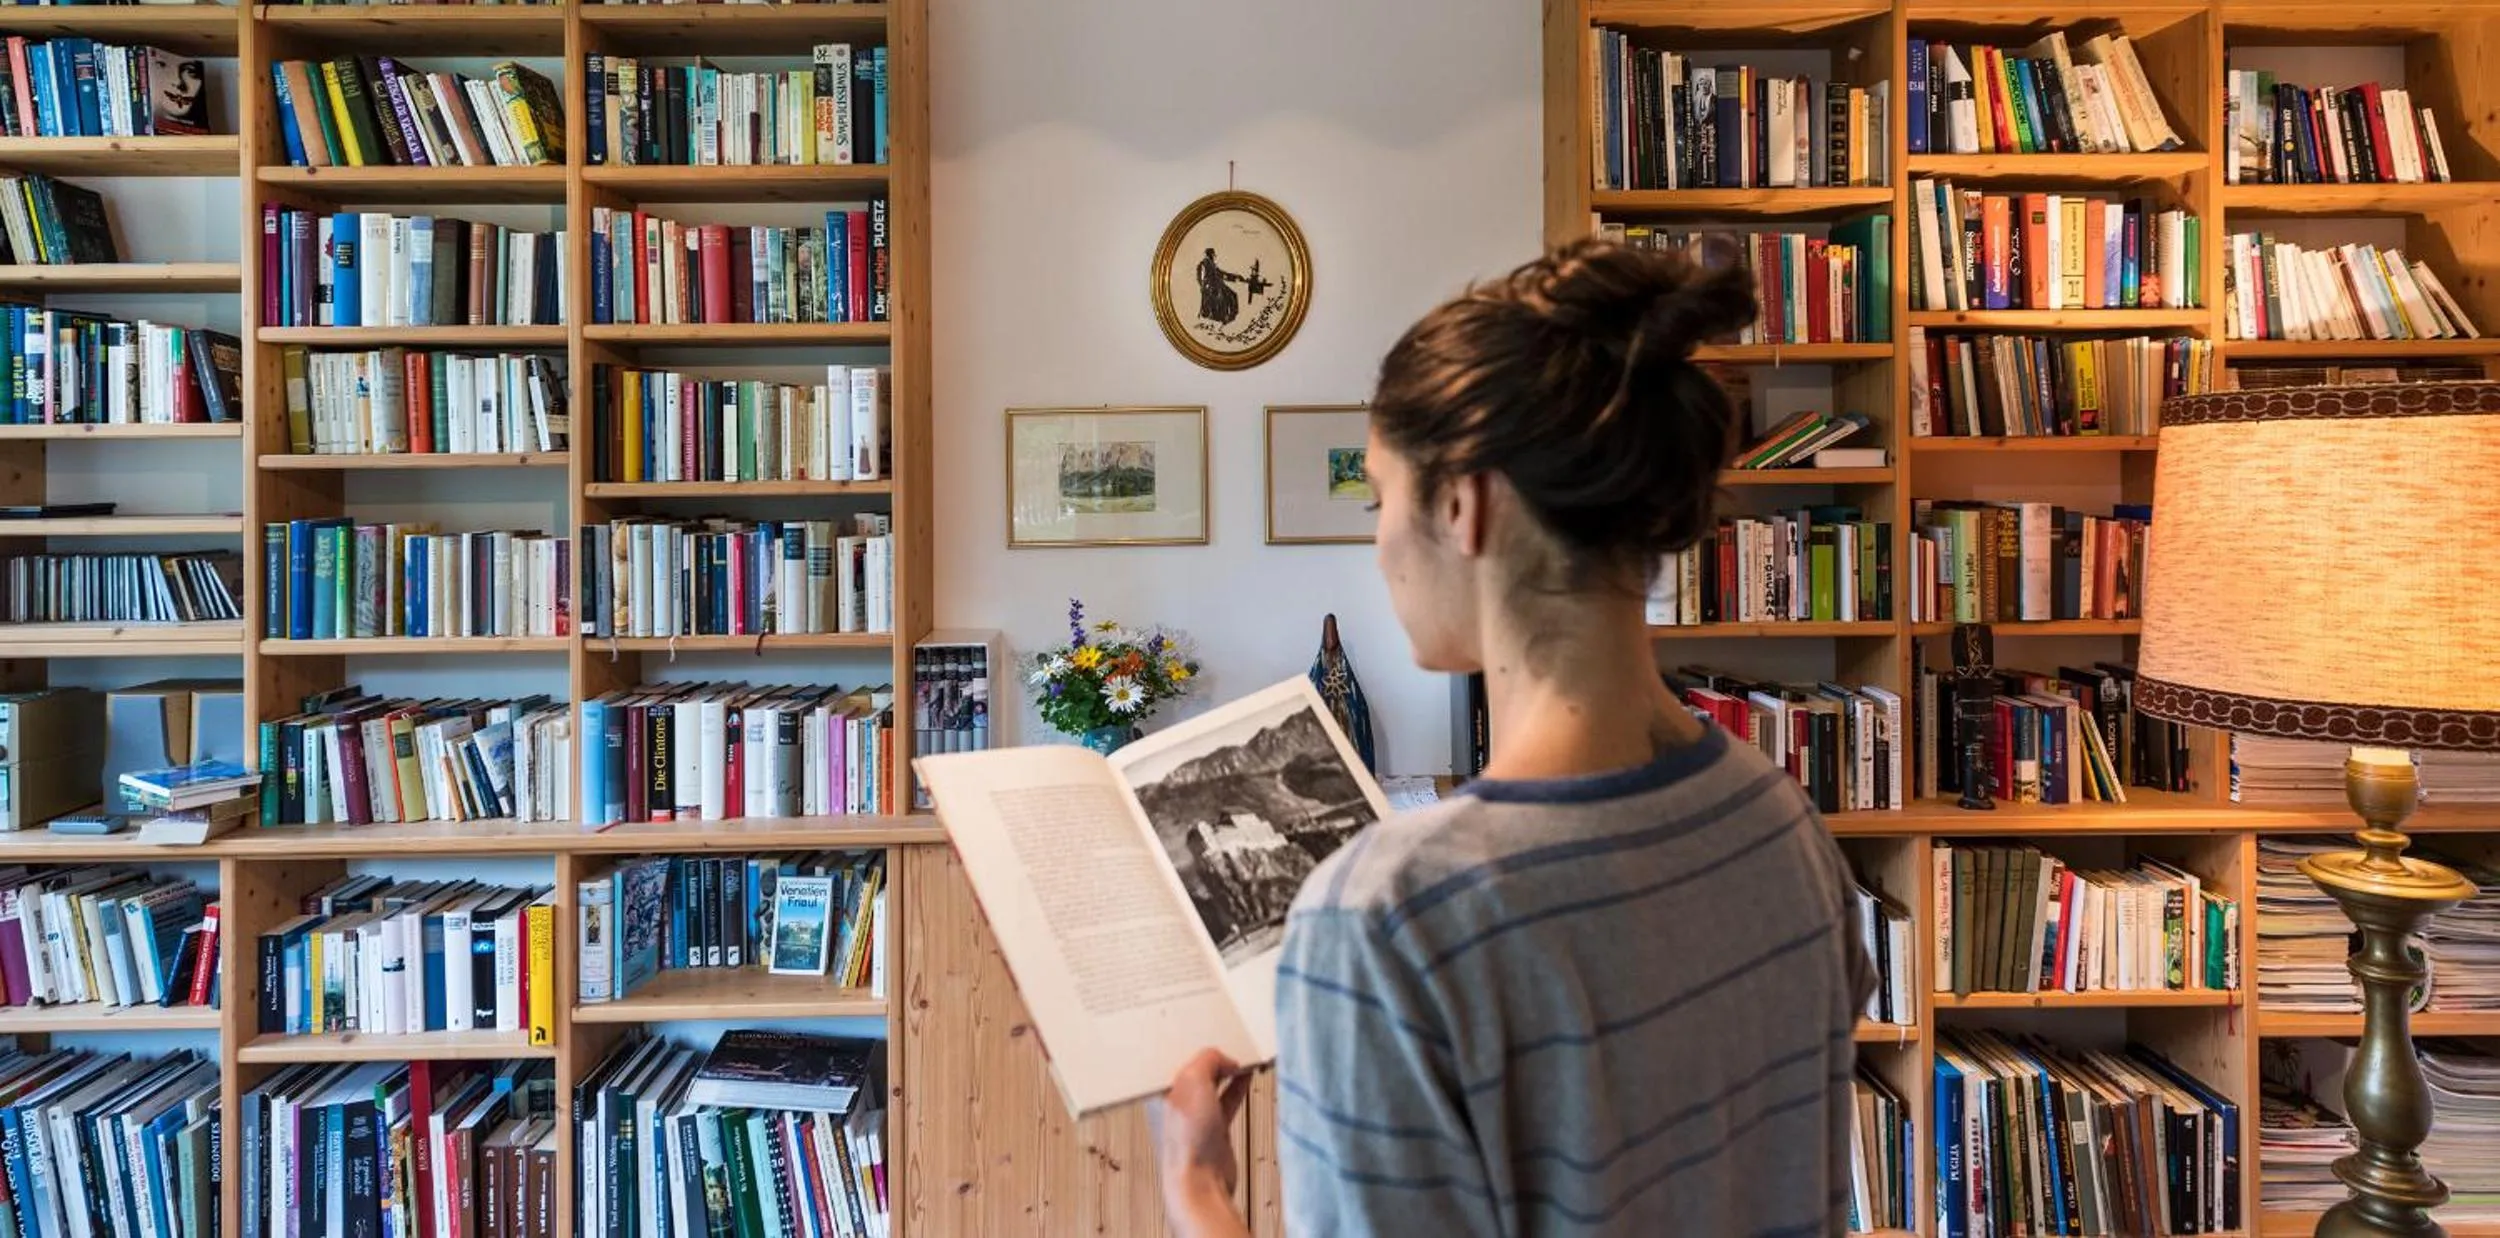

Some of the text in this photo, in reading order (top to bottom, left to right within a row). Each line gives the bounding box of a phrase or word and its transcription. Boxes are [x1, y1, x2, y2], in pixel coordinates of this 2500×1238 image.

[816, 97, 826, 132] Mein
[825, 97, 833, 141] Leben
[873, 199, 885, 247] PLOETZ
[874, 289, 885, 314] Der
[1765, 555, 1775, 616] TOSCANA
[654, 717, 666, 769] Clintons
[654, 770, 666, 791] Die
[780, 884, 827, 899] Venetien
[788, 898, 817, 907] Friaul
[211, 1122, 220, 1182] DOLOMITES
[1949, 1143, 1959, 1181] PUGLIA
